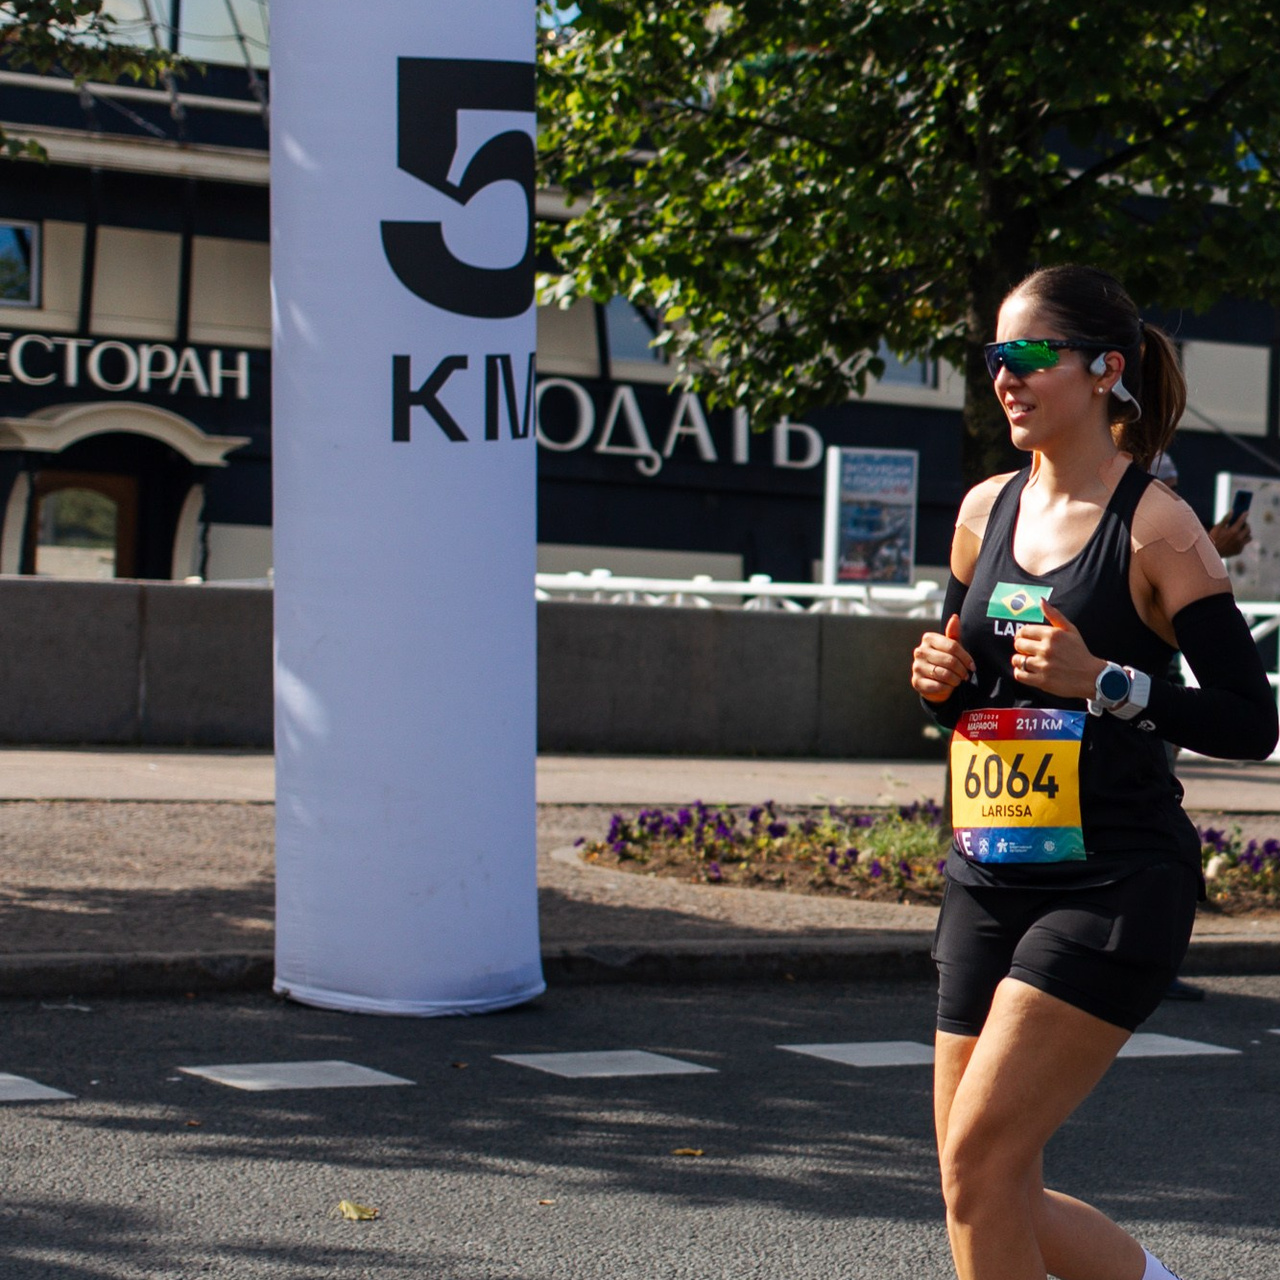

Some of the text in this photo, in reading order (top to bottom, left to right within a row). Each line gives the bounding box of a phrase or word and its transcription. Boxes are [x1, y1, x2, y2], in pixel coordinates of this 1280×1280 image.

[380, 56, 536, 320] 5
[1015, 717, 1038, 731] 21,1
[964, 753, 1060, 799] 6064
[981, 804, 1033, 817] LARISSA
